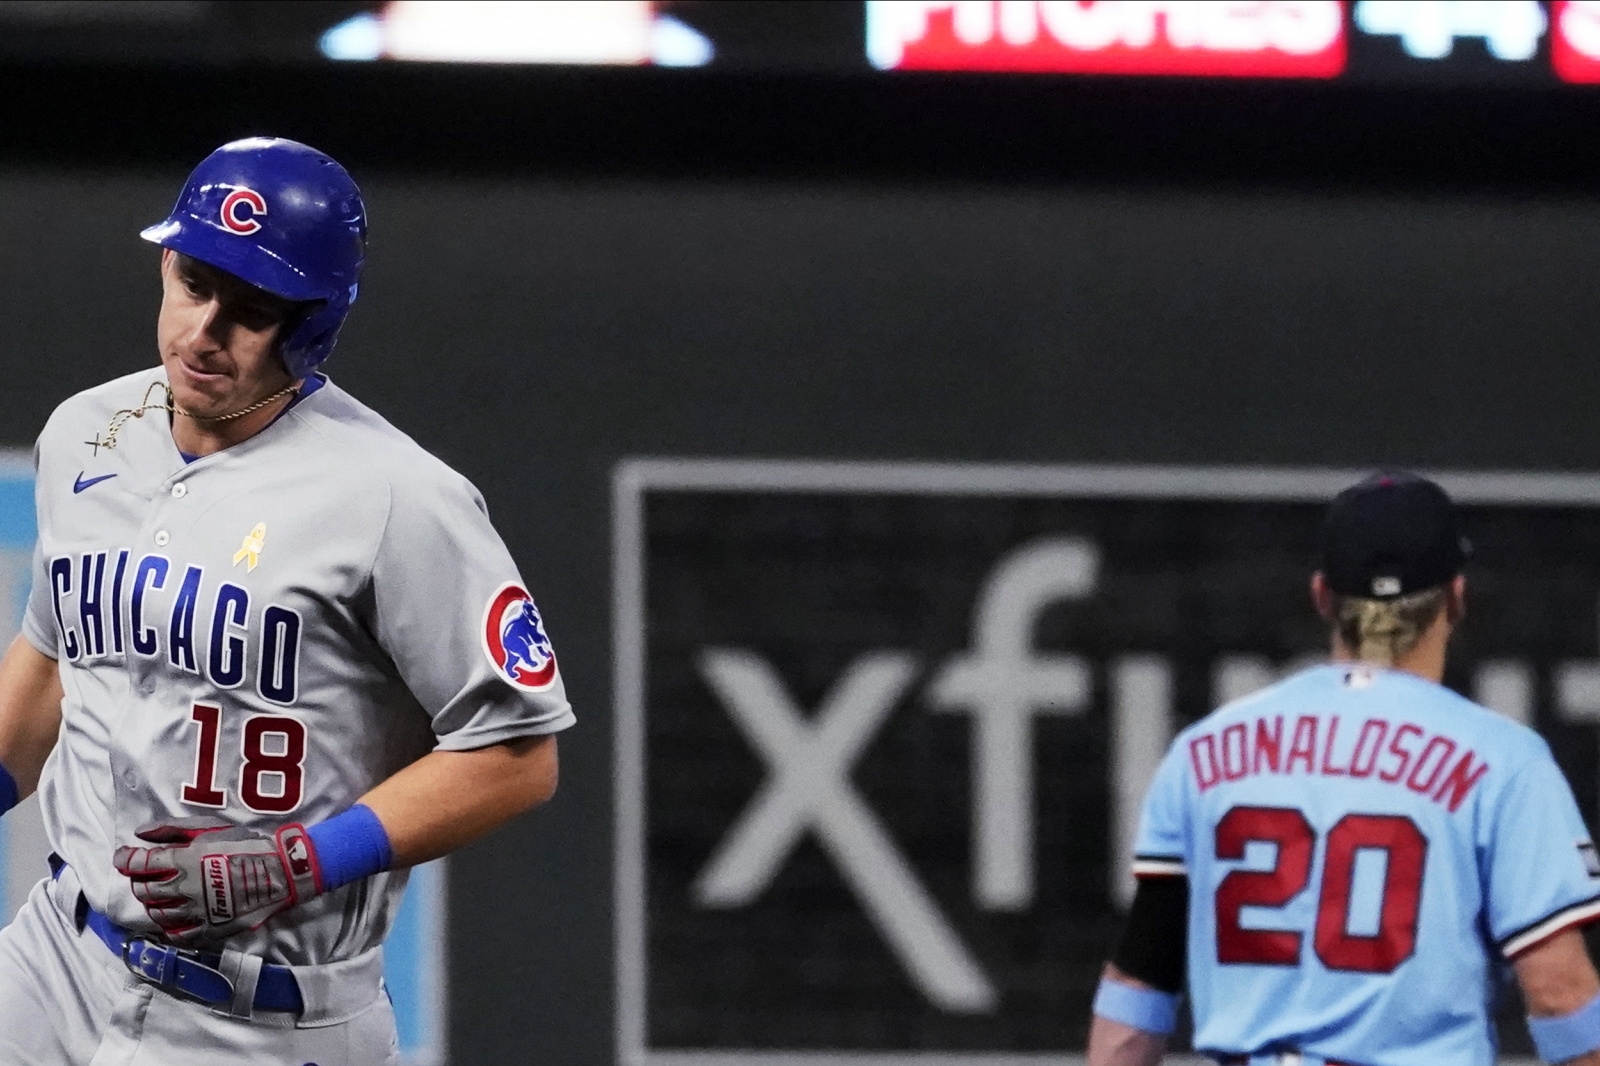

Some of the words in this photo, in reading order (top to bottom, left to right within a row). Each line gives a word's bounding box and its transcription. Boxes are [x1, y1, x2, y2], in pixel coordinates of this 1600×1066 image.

[220, 187, 268, 237] C
[49, 547, 302, 706] CHICAGO
[180, 700, 307, 815] 18
[1186, 713, 1490, 812] DONALDSON
[210, 858, 231, 919] Franklin
[1213, 804, 1429, 976] 20
